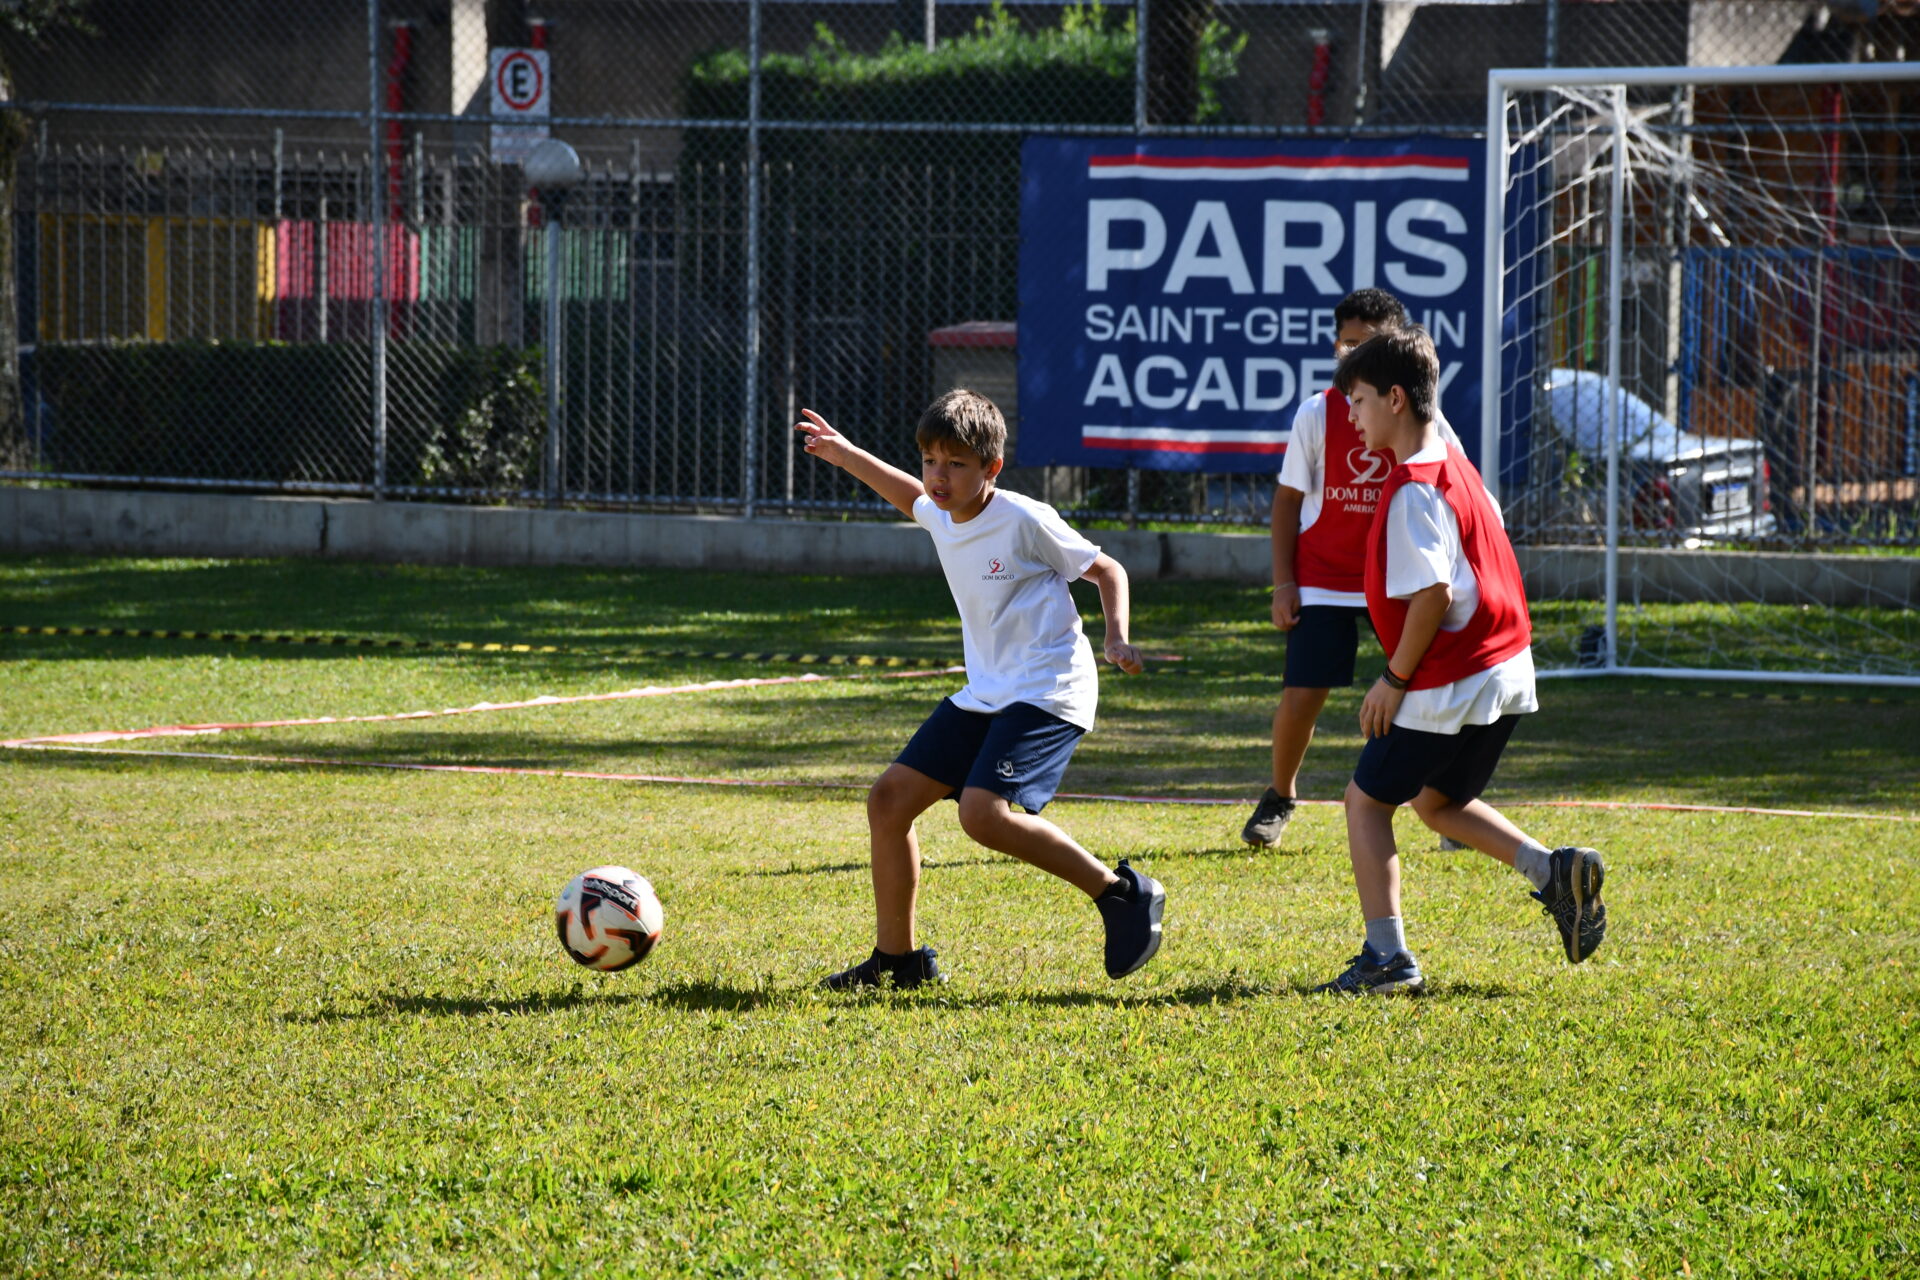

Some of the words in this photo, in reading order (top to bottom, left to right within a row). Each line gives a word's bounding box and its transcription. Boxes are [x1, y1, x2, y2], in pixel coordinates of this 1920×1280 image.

[512, 63, 528, 98] E
[1086, 198, 1468, 297] PARIS
[1085, 304, 1466, 349] SAINT-GERIN
[1084, 353, 1463, 413] ACADE
[1325, 486, 1358, 501] DOM
[1343, 503, 1376, 514] AMERIC
